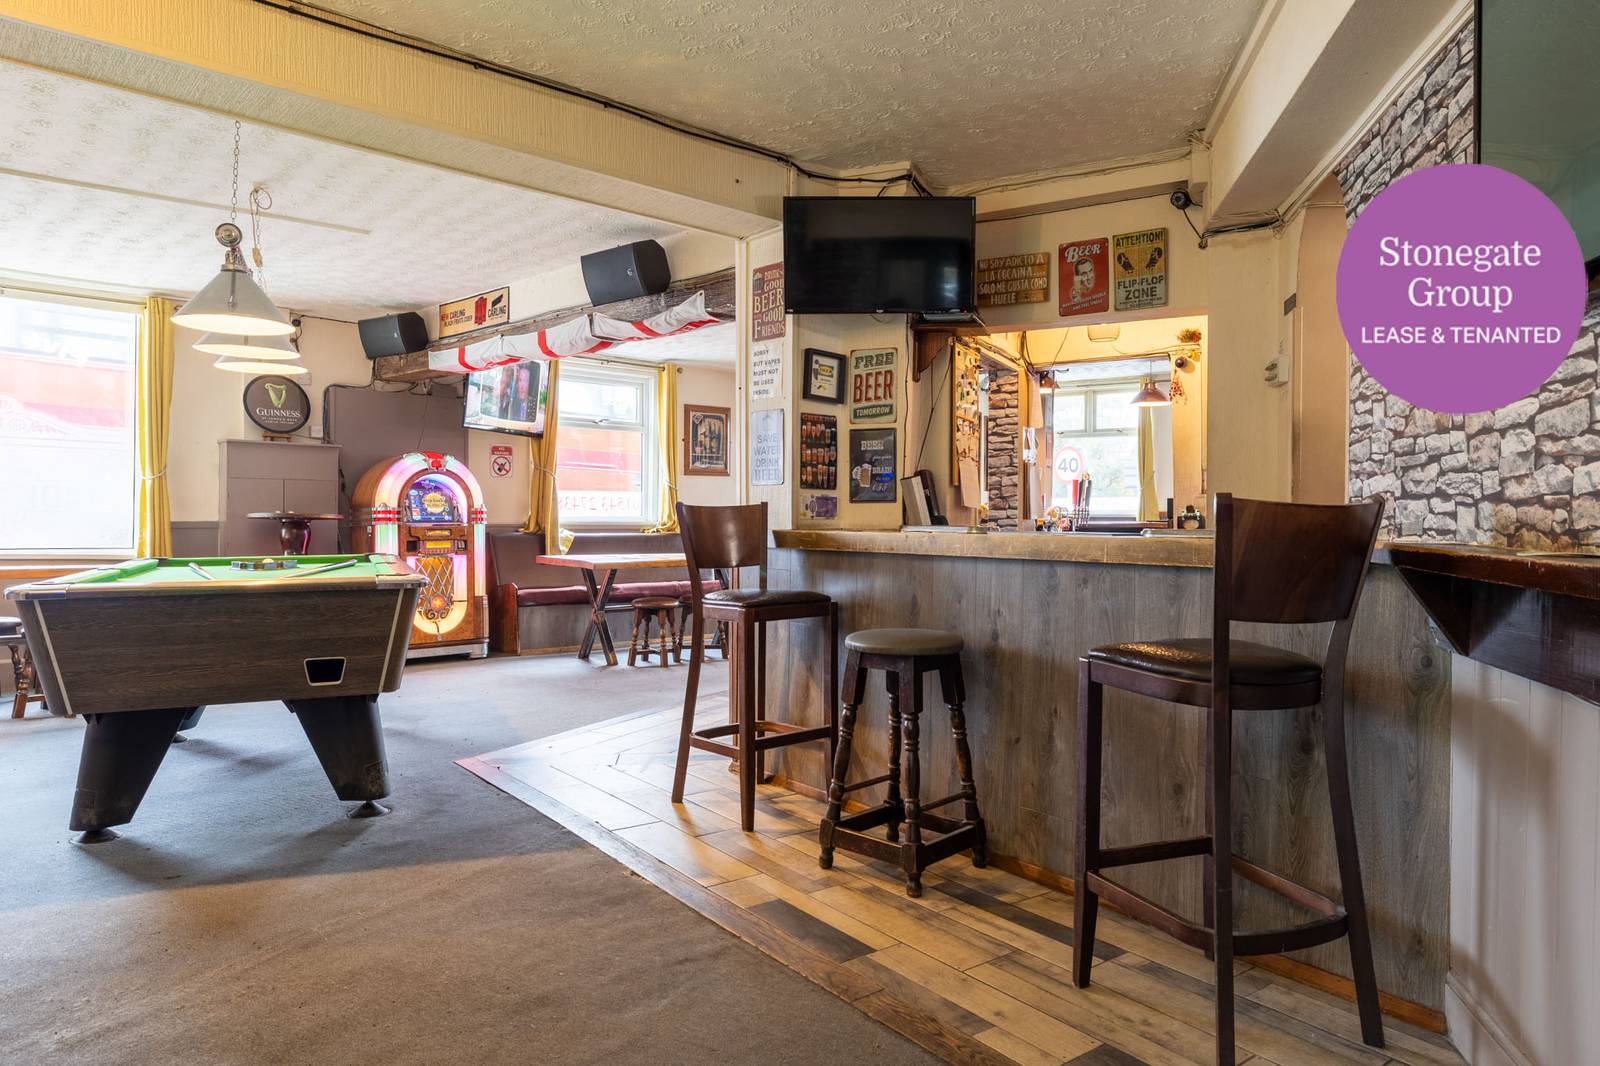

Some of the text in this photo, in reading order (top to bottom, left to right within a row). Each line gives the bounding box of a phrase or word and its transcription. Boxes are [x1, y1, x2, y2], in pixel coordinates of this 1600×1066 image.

[1116, 230, 1164, 248] ATTENTION!
[1035, 254, 1045, 265] A
[1064, 244, 1102, 263] BEER
[755, 288, 784, 313] BEER
[1125, 286, 1157, 300] ZONE
[450, 309, 465, 319] CARLING
[488, 304, 506, 318] CARLING
[763, 305, 784, 322] GOOD
[755, 319, 785, 339] FRIENDS
[854, 352, 894, 369] FREE
[853, 369, 894, 403] BEER
[256, 407, 301, 417] GUINNESS
[856, 406, 890, 416] TOMORROW
[757, 433, 778, 443] SAVE
[755, 458, 780, 468] DRINK
[1058, 457, 1079, 473] 40
